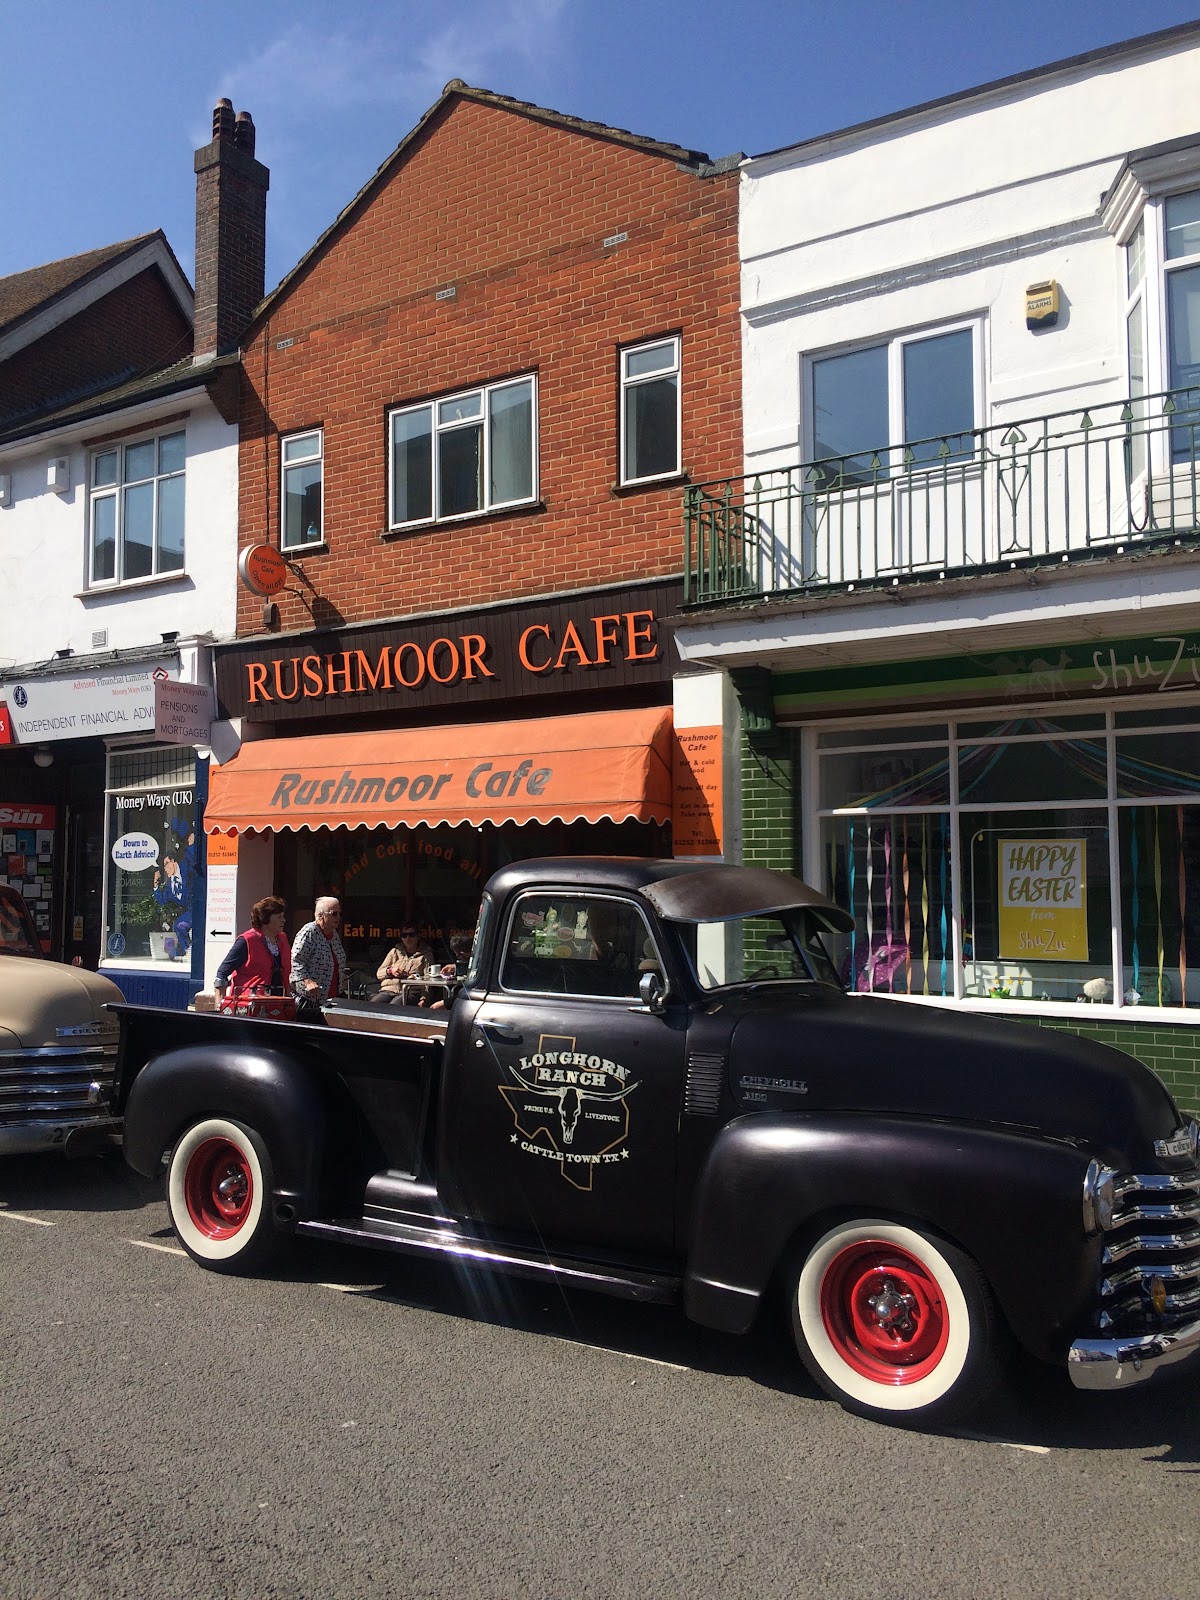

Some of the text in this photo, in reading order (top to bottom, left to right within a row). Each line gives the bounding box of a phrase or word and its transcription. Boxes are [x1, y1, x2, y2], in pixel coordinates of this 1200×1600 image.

[1027, 300, 1052, 311] ALARMS
[253, 554, 283, 567] Rushmoor
[261, 566, 274, 574] Cafe
[245, 610, 658, 703] RUSHMOOR CAFE
[73, 673, 149, 690] Advised Financial Limited
[112, 688, 128, 696] Money
[160, 684, 182, 694] Money
[160, 700, 198, 714] PENSIONS
[18, 716, 76, 733] INDEPENDENT
[80, 710, 129, 726] FINANCIAL
[172, 714, 186, 723] AND
[160, 724, 208, 739] MORTGAGES
[677, 734, 718, 743] Rushmoor
[688, 744, 707, 752] Cafe
[270, 760, 553, 810] Rushmoor Cafe
[706, 784, 718, 792] day
[116, 790, 192, 812] Money Ways (UK)
[0, 808, 44, 824] Sun
[123, 839, 140, 848] Down
[116, 850, 156, 859] Earth Advice!
[344, 852, 368, 881] and
[418, 840, 454, 860] food
[460, 859, 482, 880] all
[1008, 846, 1076, 876] HAPPY
[1008, 876, 1076, 902] EASTER
[1030, 909, 1056, 922] from
[344, 924, 364, 938] Eat
[370, 924, 380, 938] in
[386, 926, 400, 938] an
[1018, 929, 1067, 953] ShuZu
[519, 1052, 631, 1080] LONGHORN
[538, 1068, 606, 1087] RANCH
[742, 1076, 808, 1092] CHEVROLET
[524, 1104, 554, 1115] PRIME U.S.
[584, 1112, 620, 1122] LIVESTOCK
[520, 1141, 620, 1164] CATTLE TOWN TX
